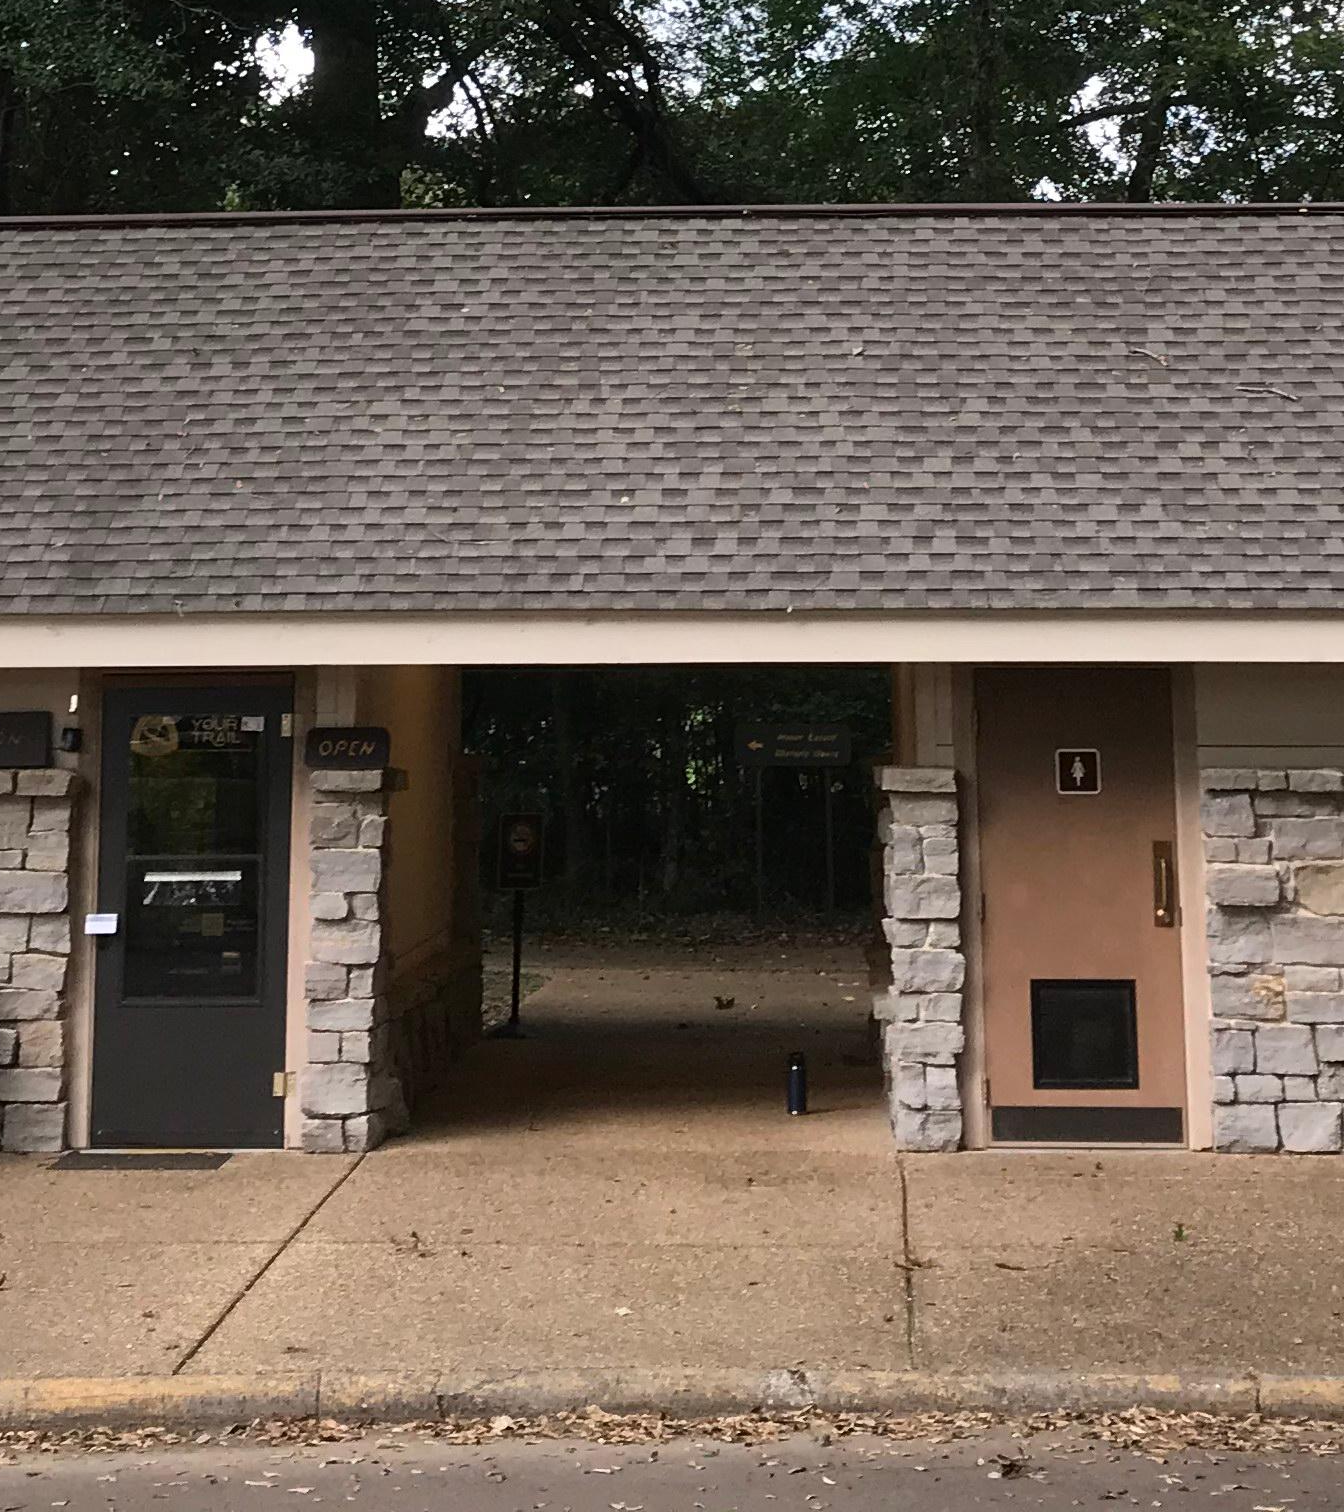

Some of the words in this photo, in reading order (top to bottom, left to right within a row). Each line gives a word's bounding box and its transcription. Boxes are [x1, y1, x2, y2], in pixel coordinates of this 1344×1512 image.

[192, 718, 238, 730] YOUR
[191, 731, 241, 746] TRAIL
[319, 739, 376, 756] OPEN
